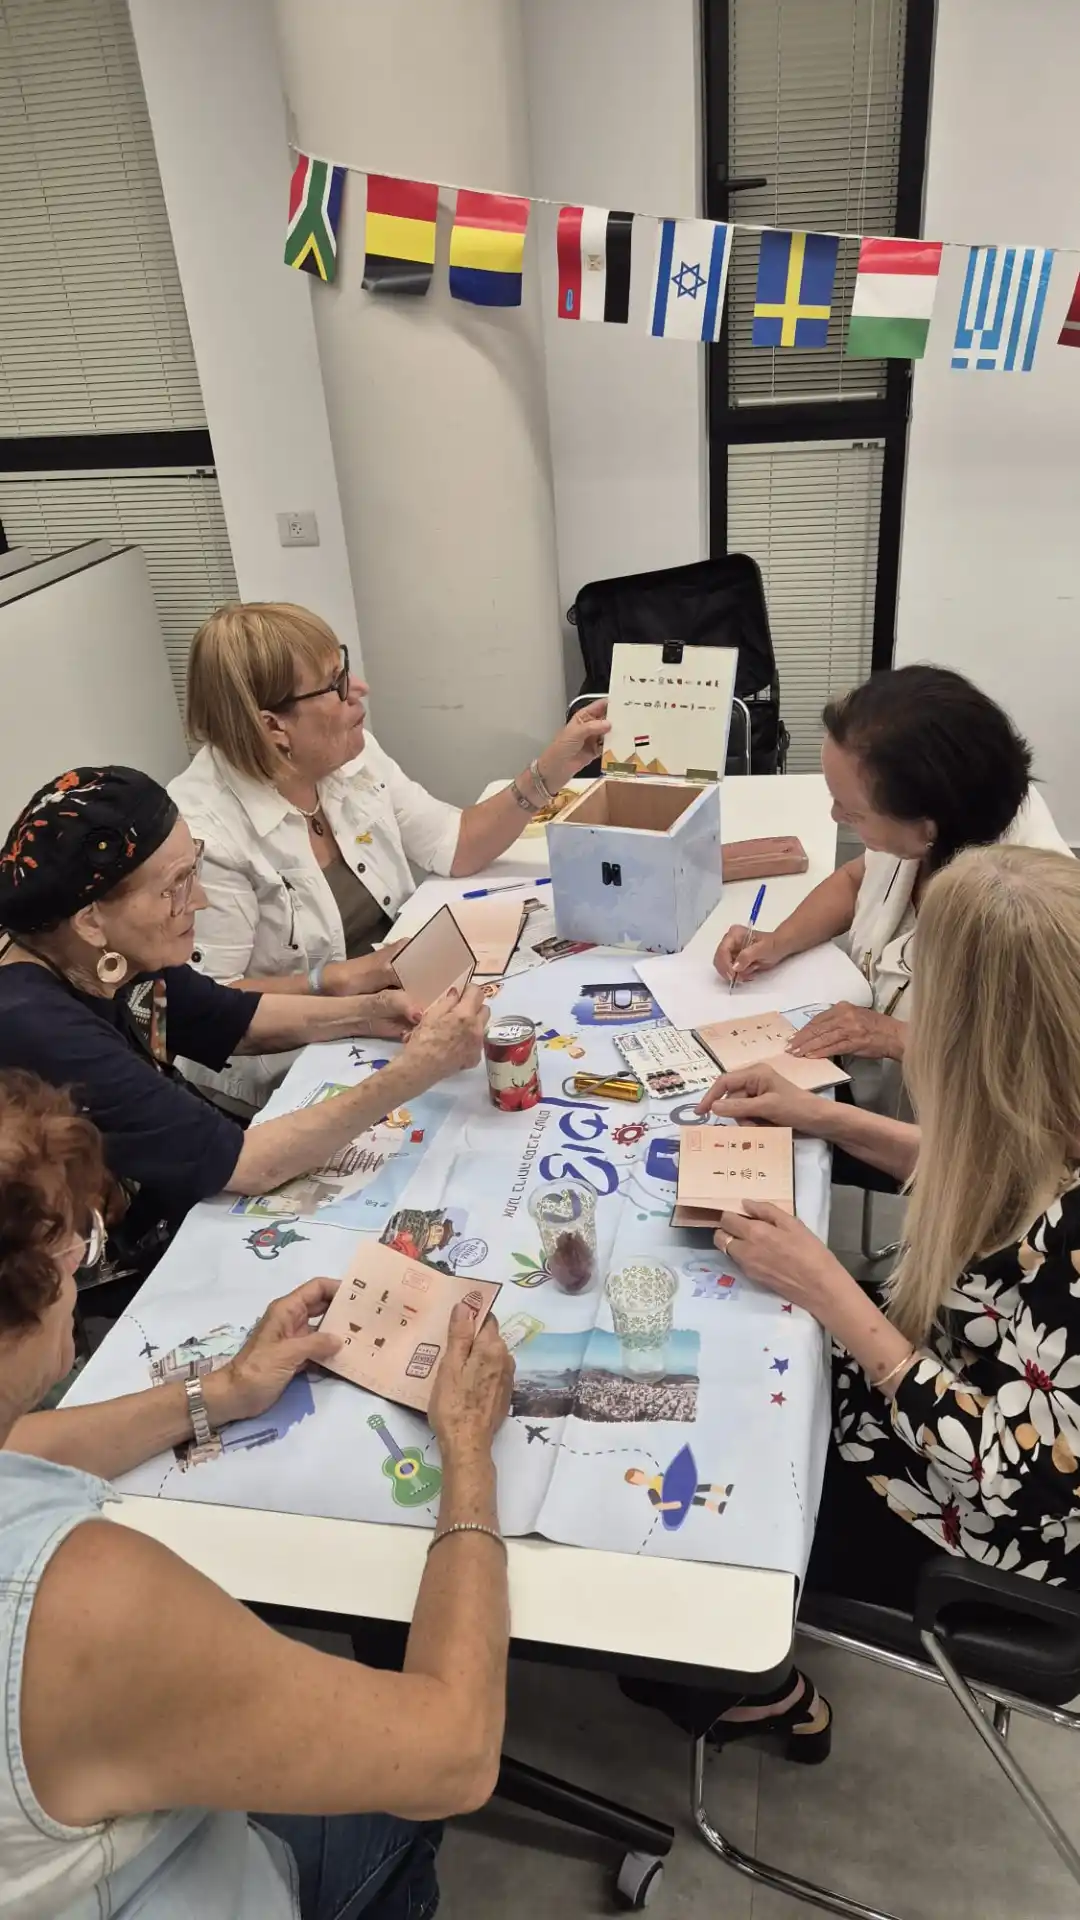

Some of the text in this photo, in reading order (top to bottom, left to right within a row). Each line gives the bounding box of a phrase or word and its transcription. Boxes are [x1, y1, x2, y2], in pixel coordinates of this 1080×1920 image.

[502, 1110, 551, 1218] אתגר בריחה מסביב לעולם
